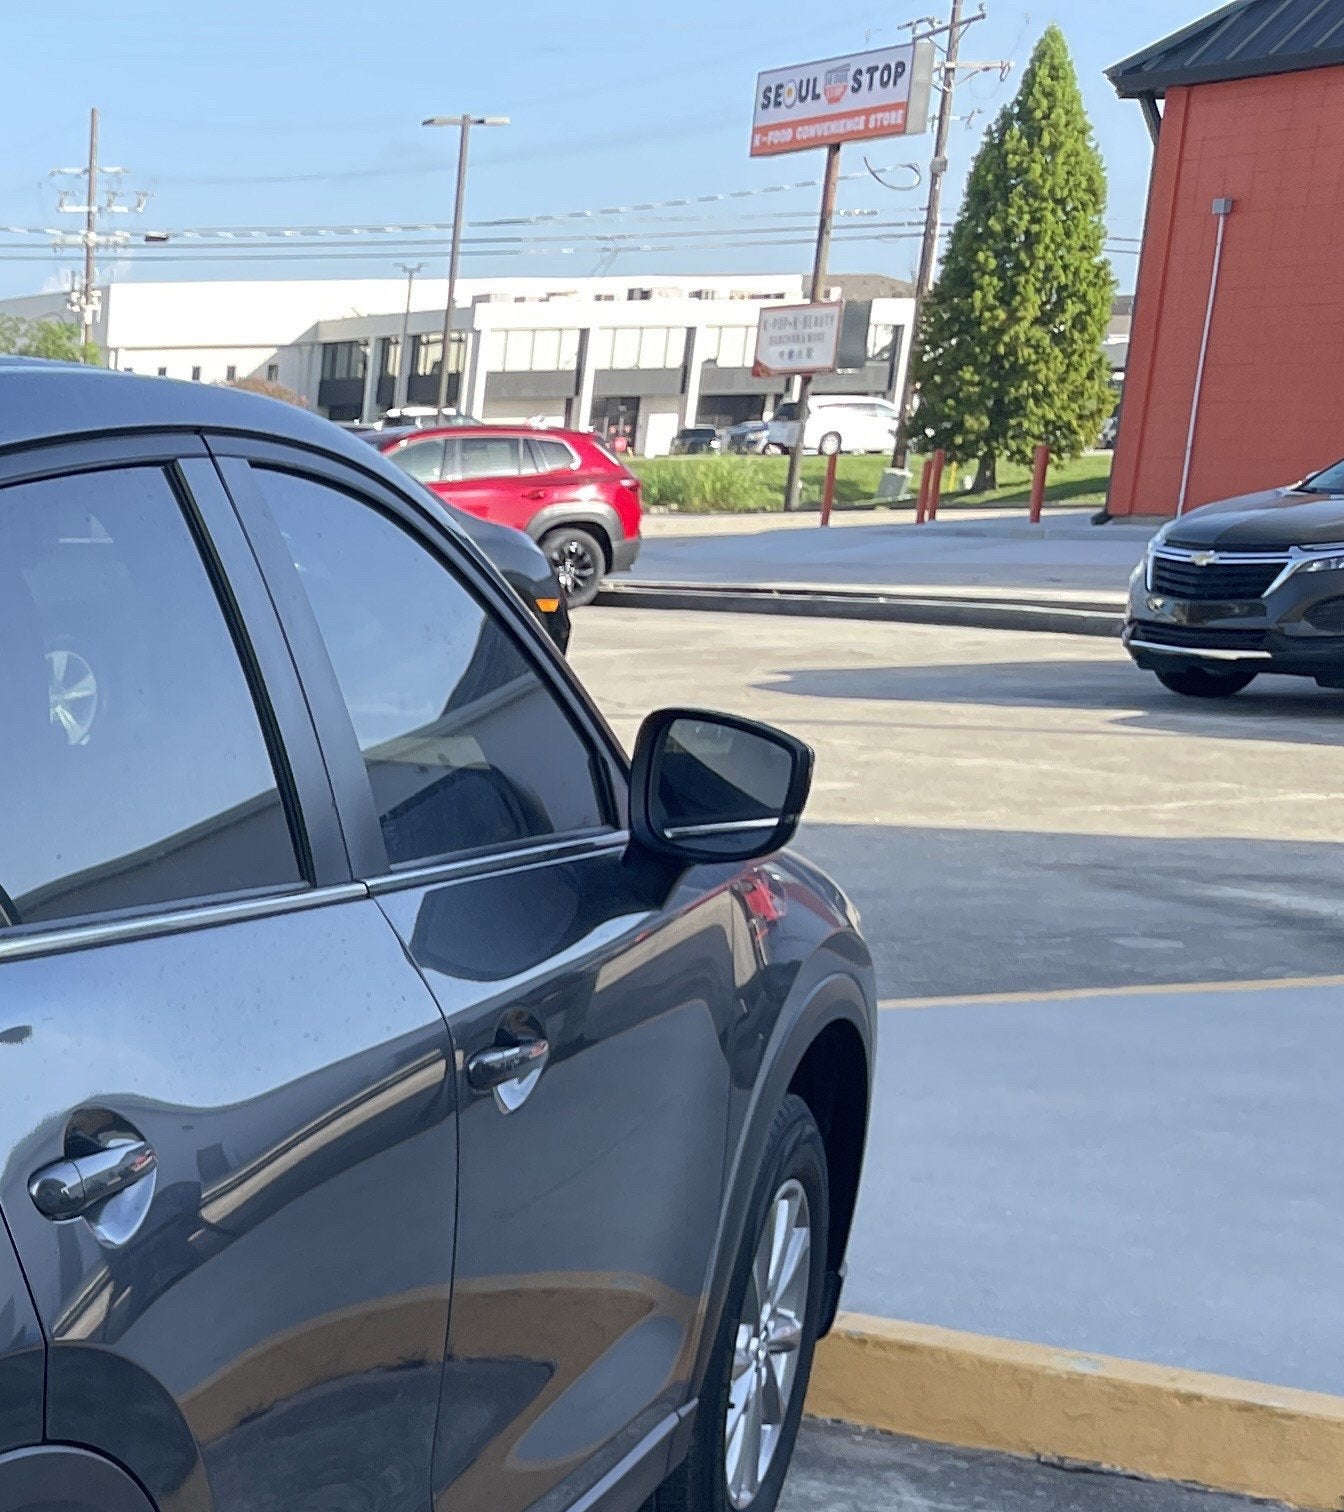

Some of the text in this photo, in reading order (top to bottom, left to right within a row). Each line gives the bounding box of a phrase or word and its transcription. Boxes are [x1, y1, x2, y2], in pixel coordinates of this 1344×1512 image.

[761, 60, 906, 111] SEOUL STOP
[868, 108, 904, 129] STORE
